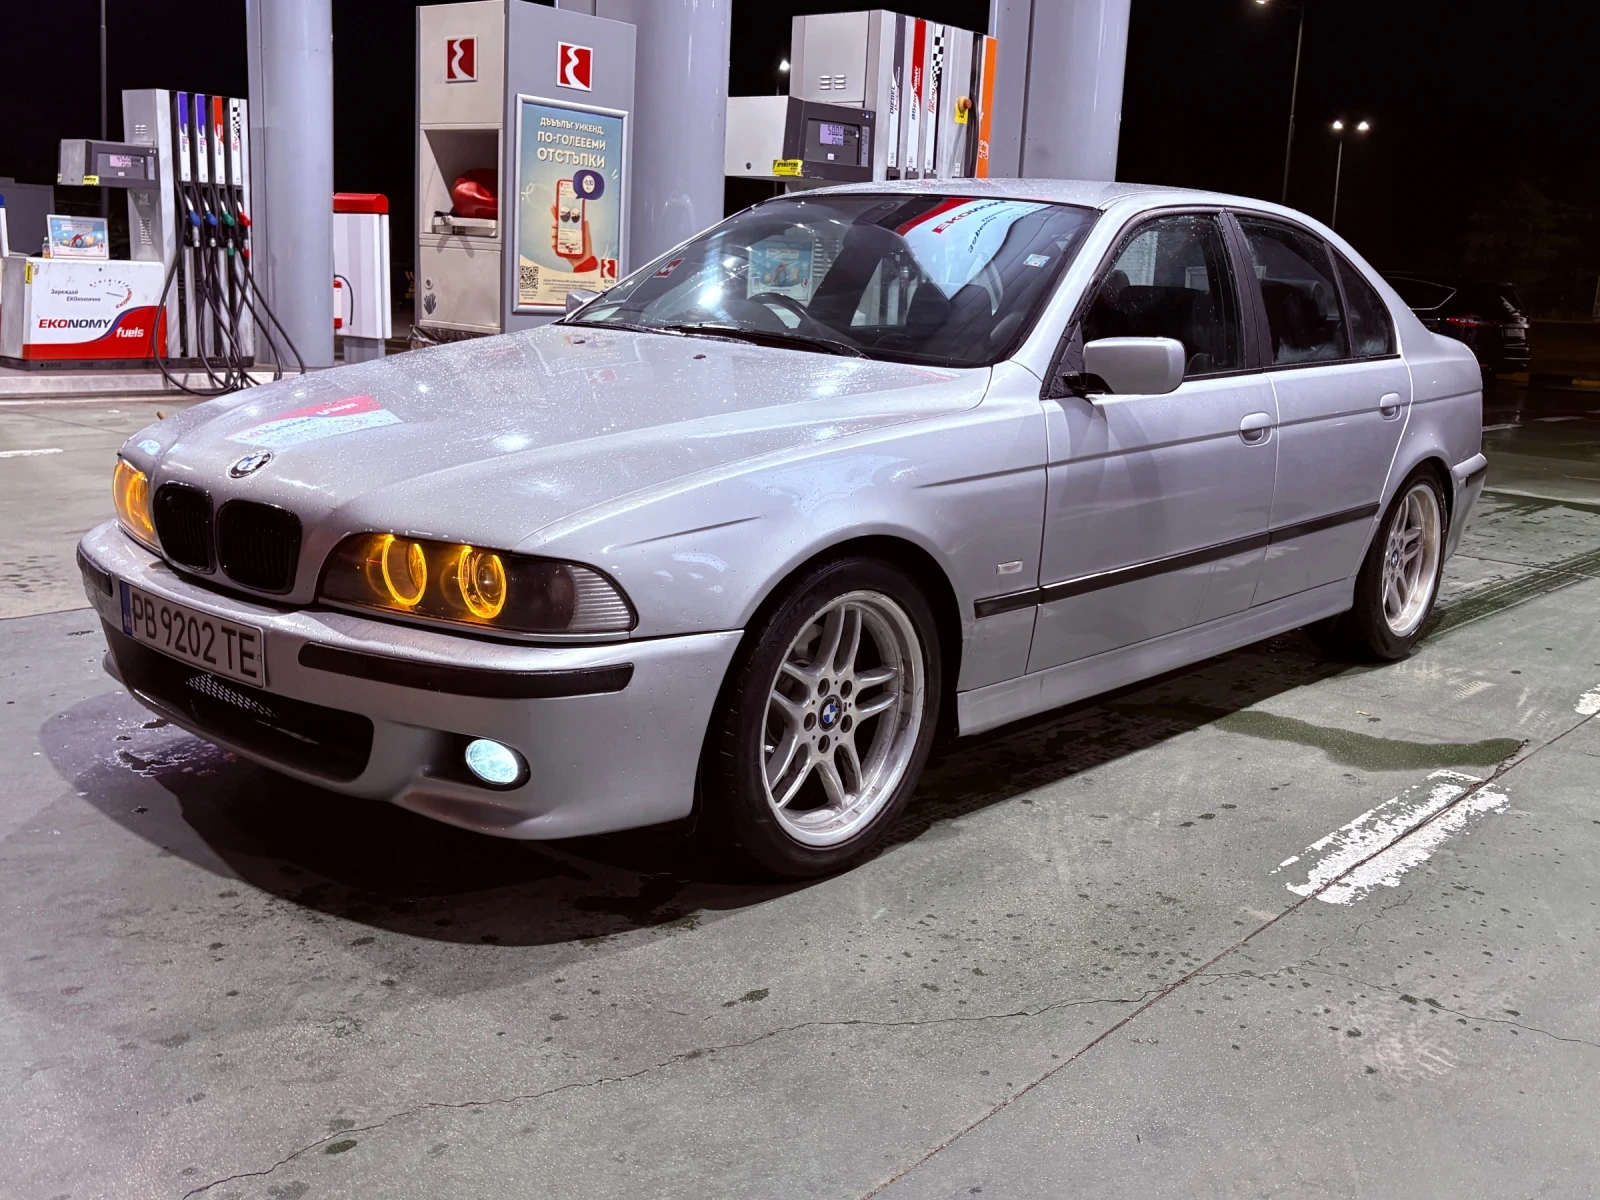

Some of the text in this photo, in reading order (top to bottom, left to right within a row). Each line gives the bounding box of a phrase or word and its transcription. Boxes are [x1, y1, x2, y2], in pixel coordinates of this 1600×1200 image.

[540, 116, 604, 135] ДЪЪЪЛЪГ УИКЕНД,
[537, 131, 606, 150] ПО-ГОЛЕЕЕМИ
[537, 148, 605, 168] ОТСТЪПКИ
[38, 319, 112, 328] EKONOMY
[116, 327, 144, 338] fuels
[132, 592, 257, 678] PB 9202 TE
